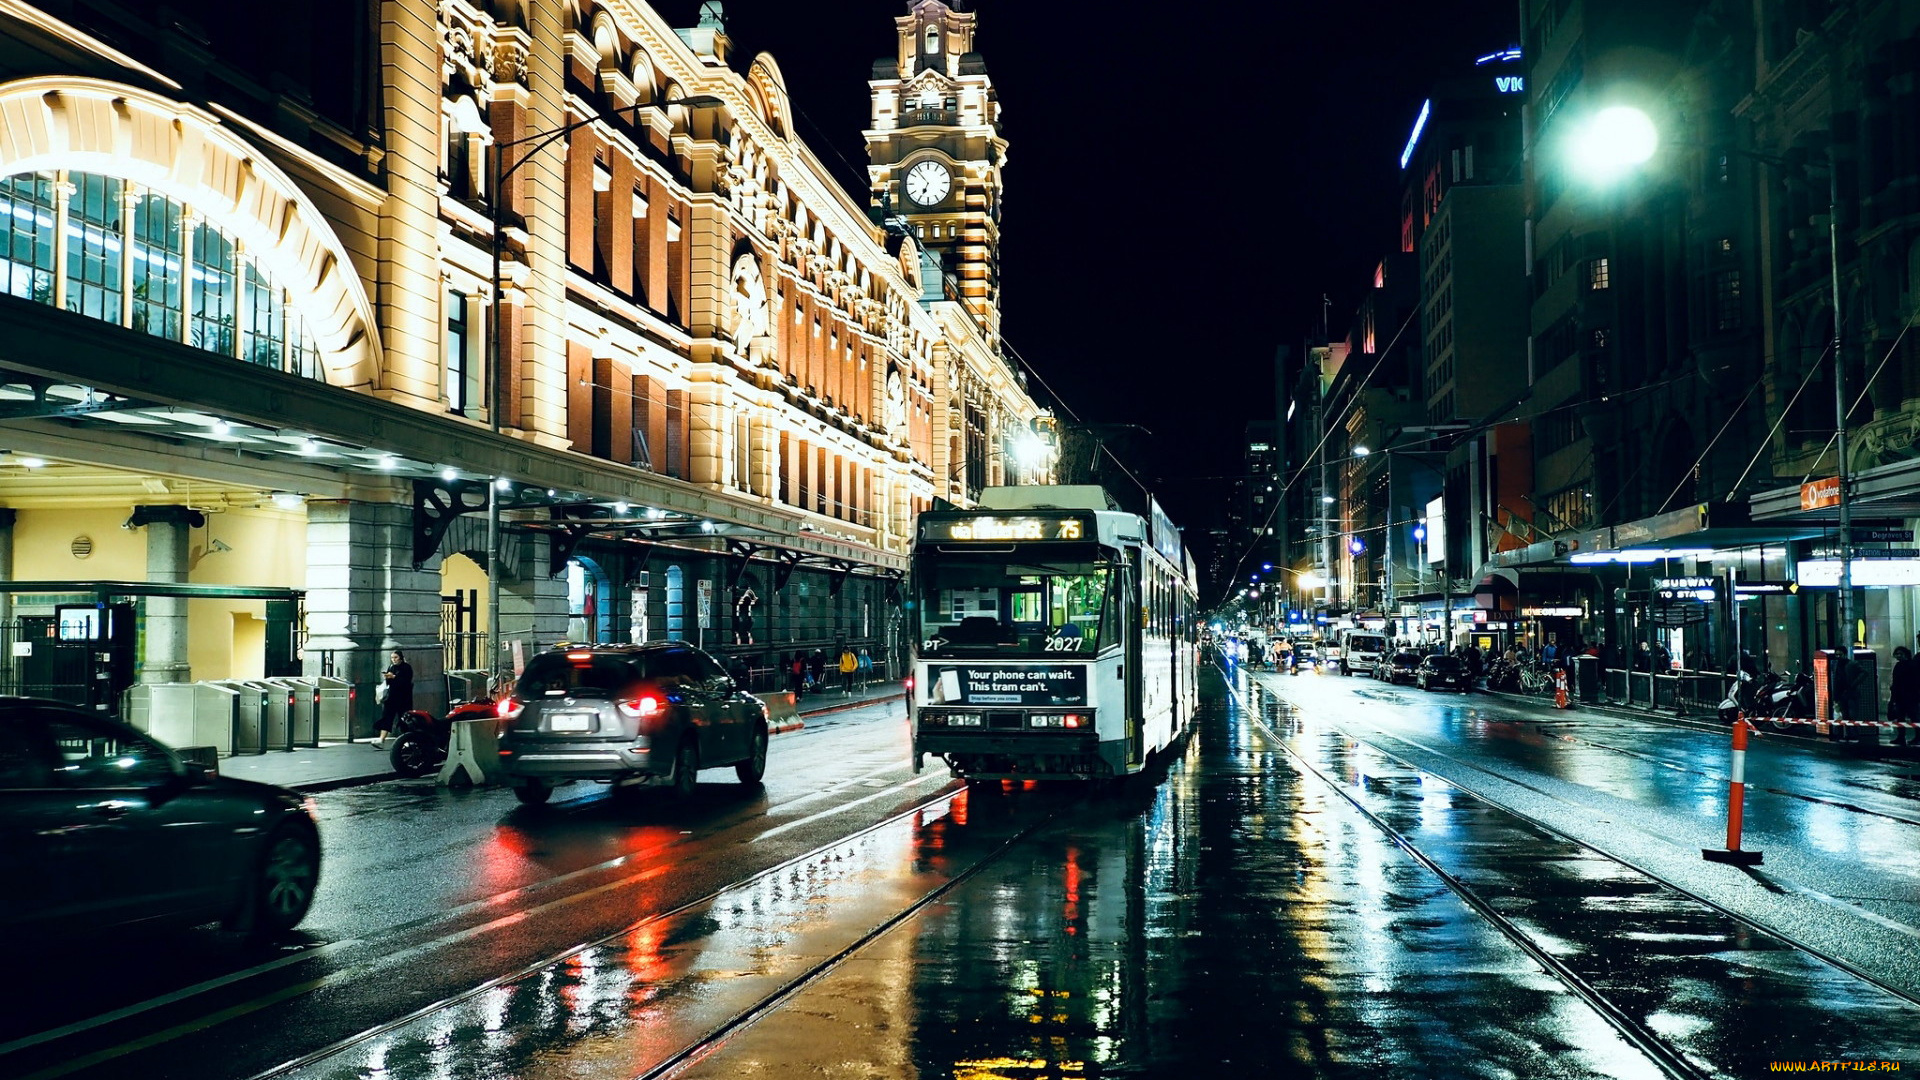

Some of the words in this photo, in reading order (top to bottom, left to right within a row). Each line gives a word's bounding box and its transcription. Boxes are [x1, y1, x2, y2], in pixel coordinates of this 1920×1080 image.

[1816, 486, 1839, 498] vodafone
[1061, 521, 1080, 538] 75
[1858, 549, 1880, 557] STATION
[1892, 549, 1914, 557] SUBWAY
[1661, 578, 1715, 588] SUBWAY
[1659, 590, 1672, 599] TO
[1044, 637, 1082, 652] 2027
[968, 670, 990, 680] Your
[993, 670, 1025, 681] phone
[1027, 672, 1046, 680] can
[1048, 670, 1075, 680] wait.
[968, 682, 990, 691] This
[992, 682, 1018, 691] tram
[1020, 682, 1048, 691] can't.
